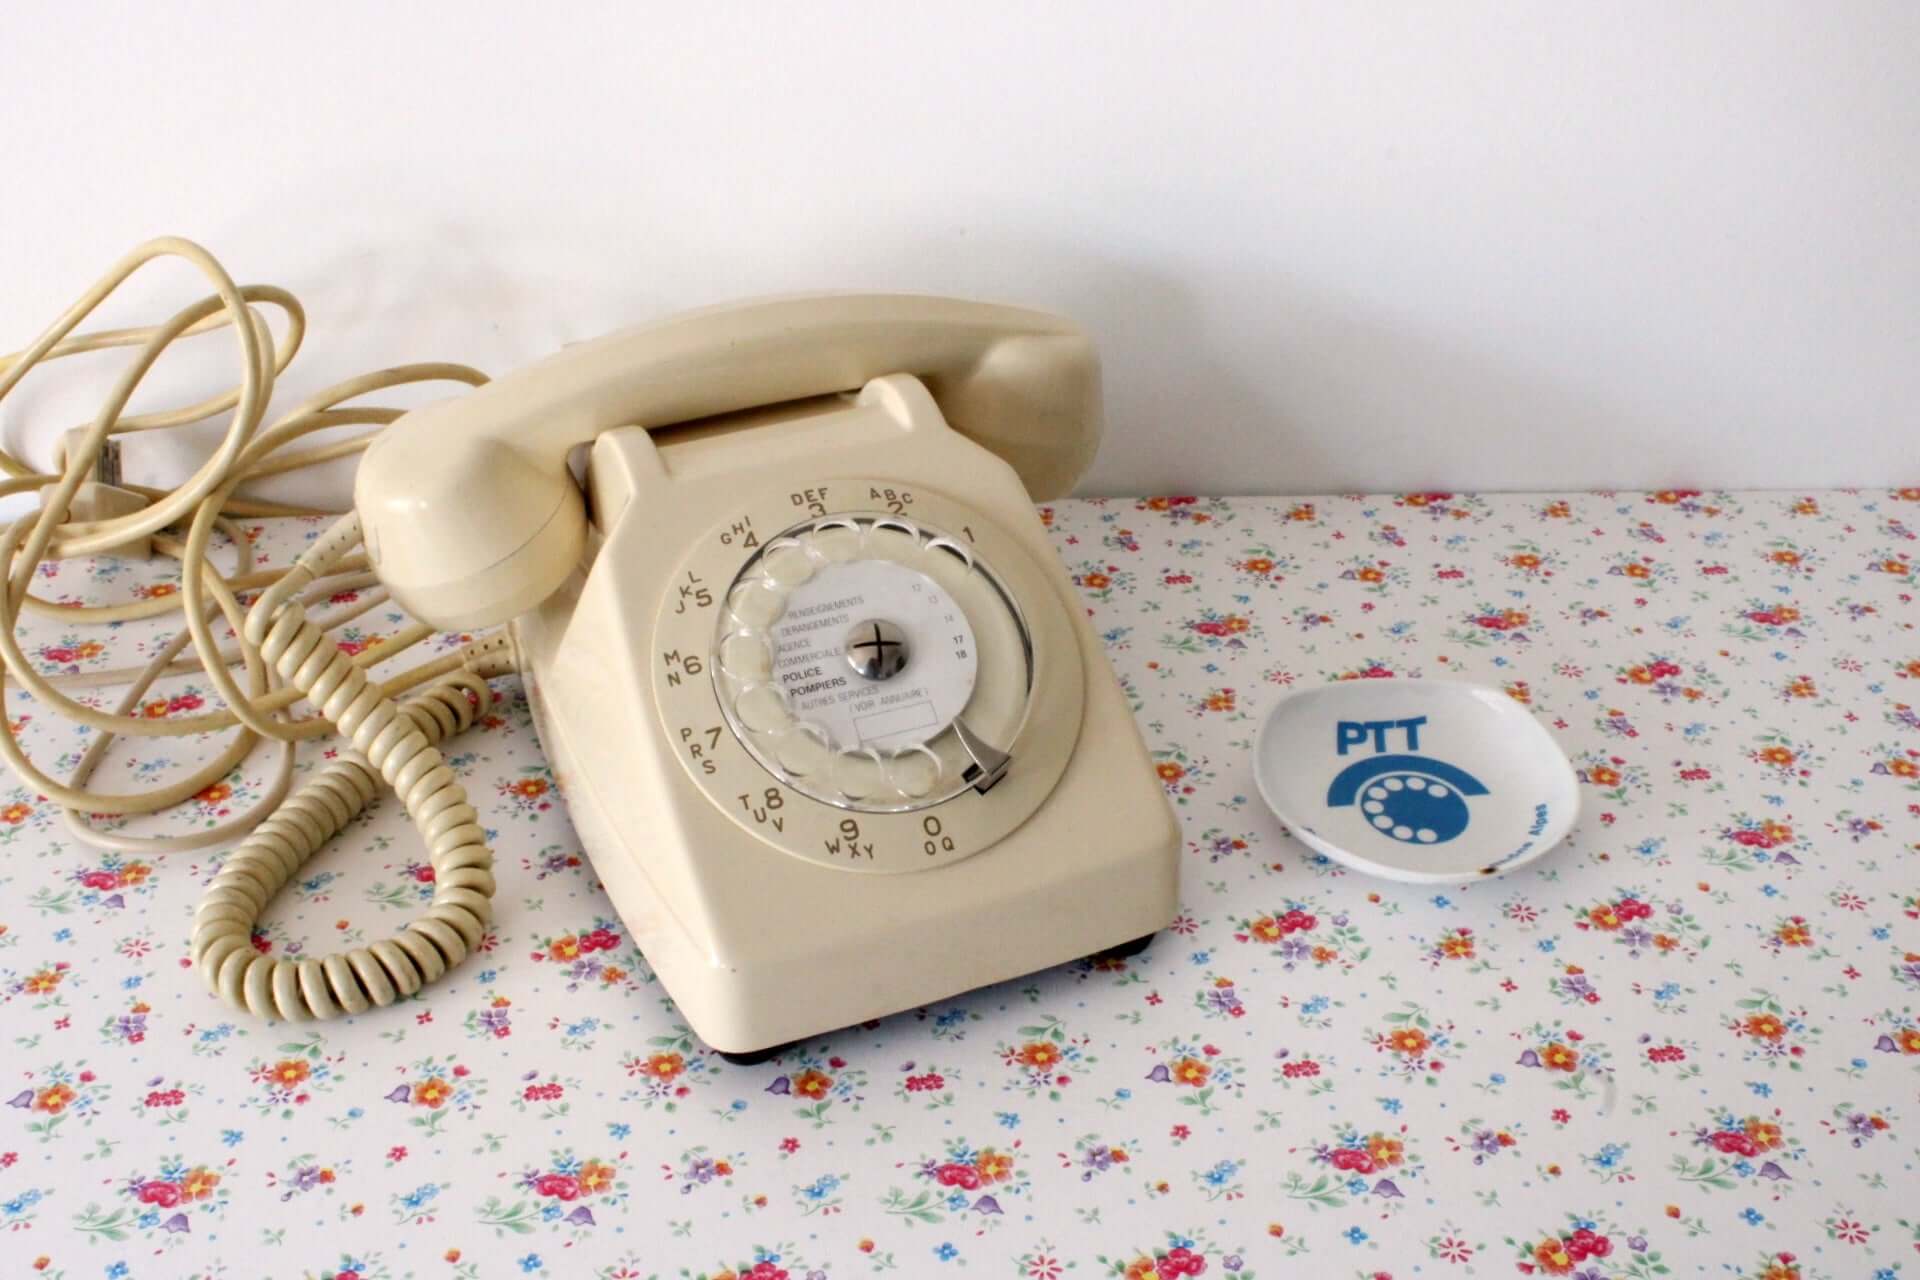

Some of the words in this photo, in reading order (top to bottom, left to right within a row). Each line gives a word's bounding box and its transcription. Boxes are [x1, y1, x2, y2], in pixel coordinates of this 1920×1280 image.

[790, 487, 829, 506] DEF
[869, 487, 914, 504] ABC
[807, 502, 827, 518] 3
[887, 501, 908, 516] 2
[720, 515, 752, 545] GHI
[743, 531, 759, 548] 4
[962, 526, 976, 543] 1
[695, 588, 713, 607] 5
[952, 634, 964, 644] 17
[955, 649, 968, 659] 18
[683, 655, 703, 675] 6
[782, 666, 823, 683] POLICE
[790, 676, 847, 697] POMPIERS
[705, 727, 722, 750] 7
[1336, 715, 1427, 755] PTT
[764, 788, 784, 810] 8
[839, 819, 860, 841] 9
[824, 838, 873, 860] WXY
